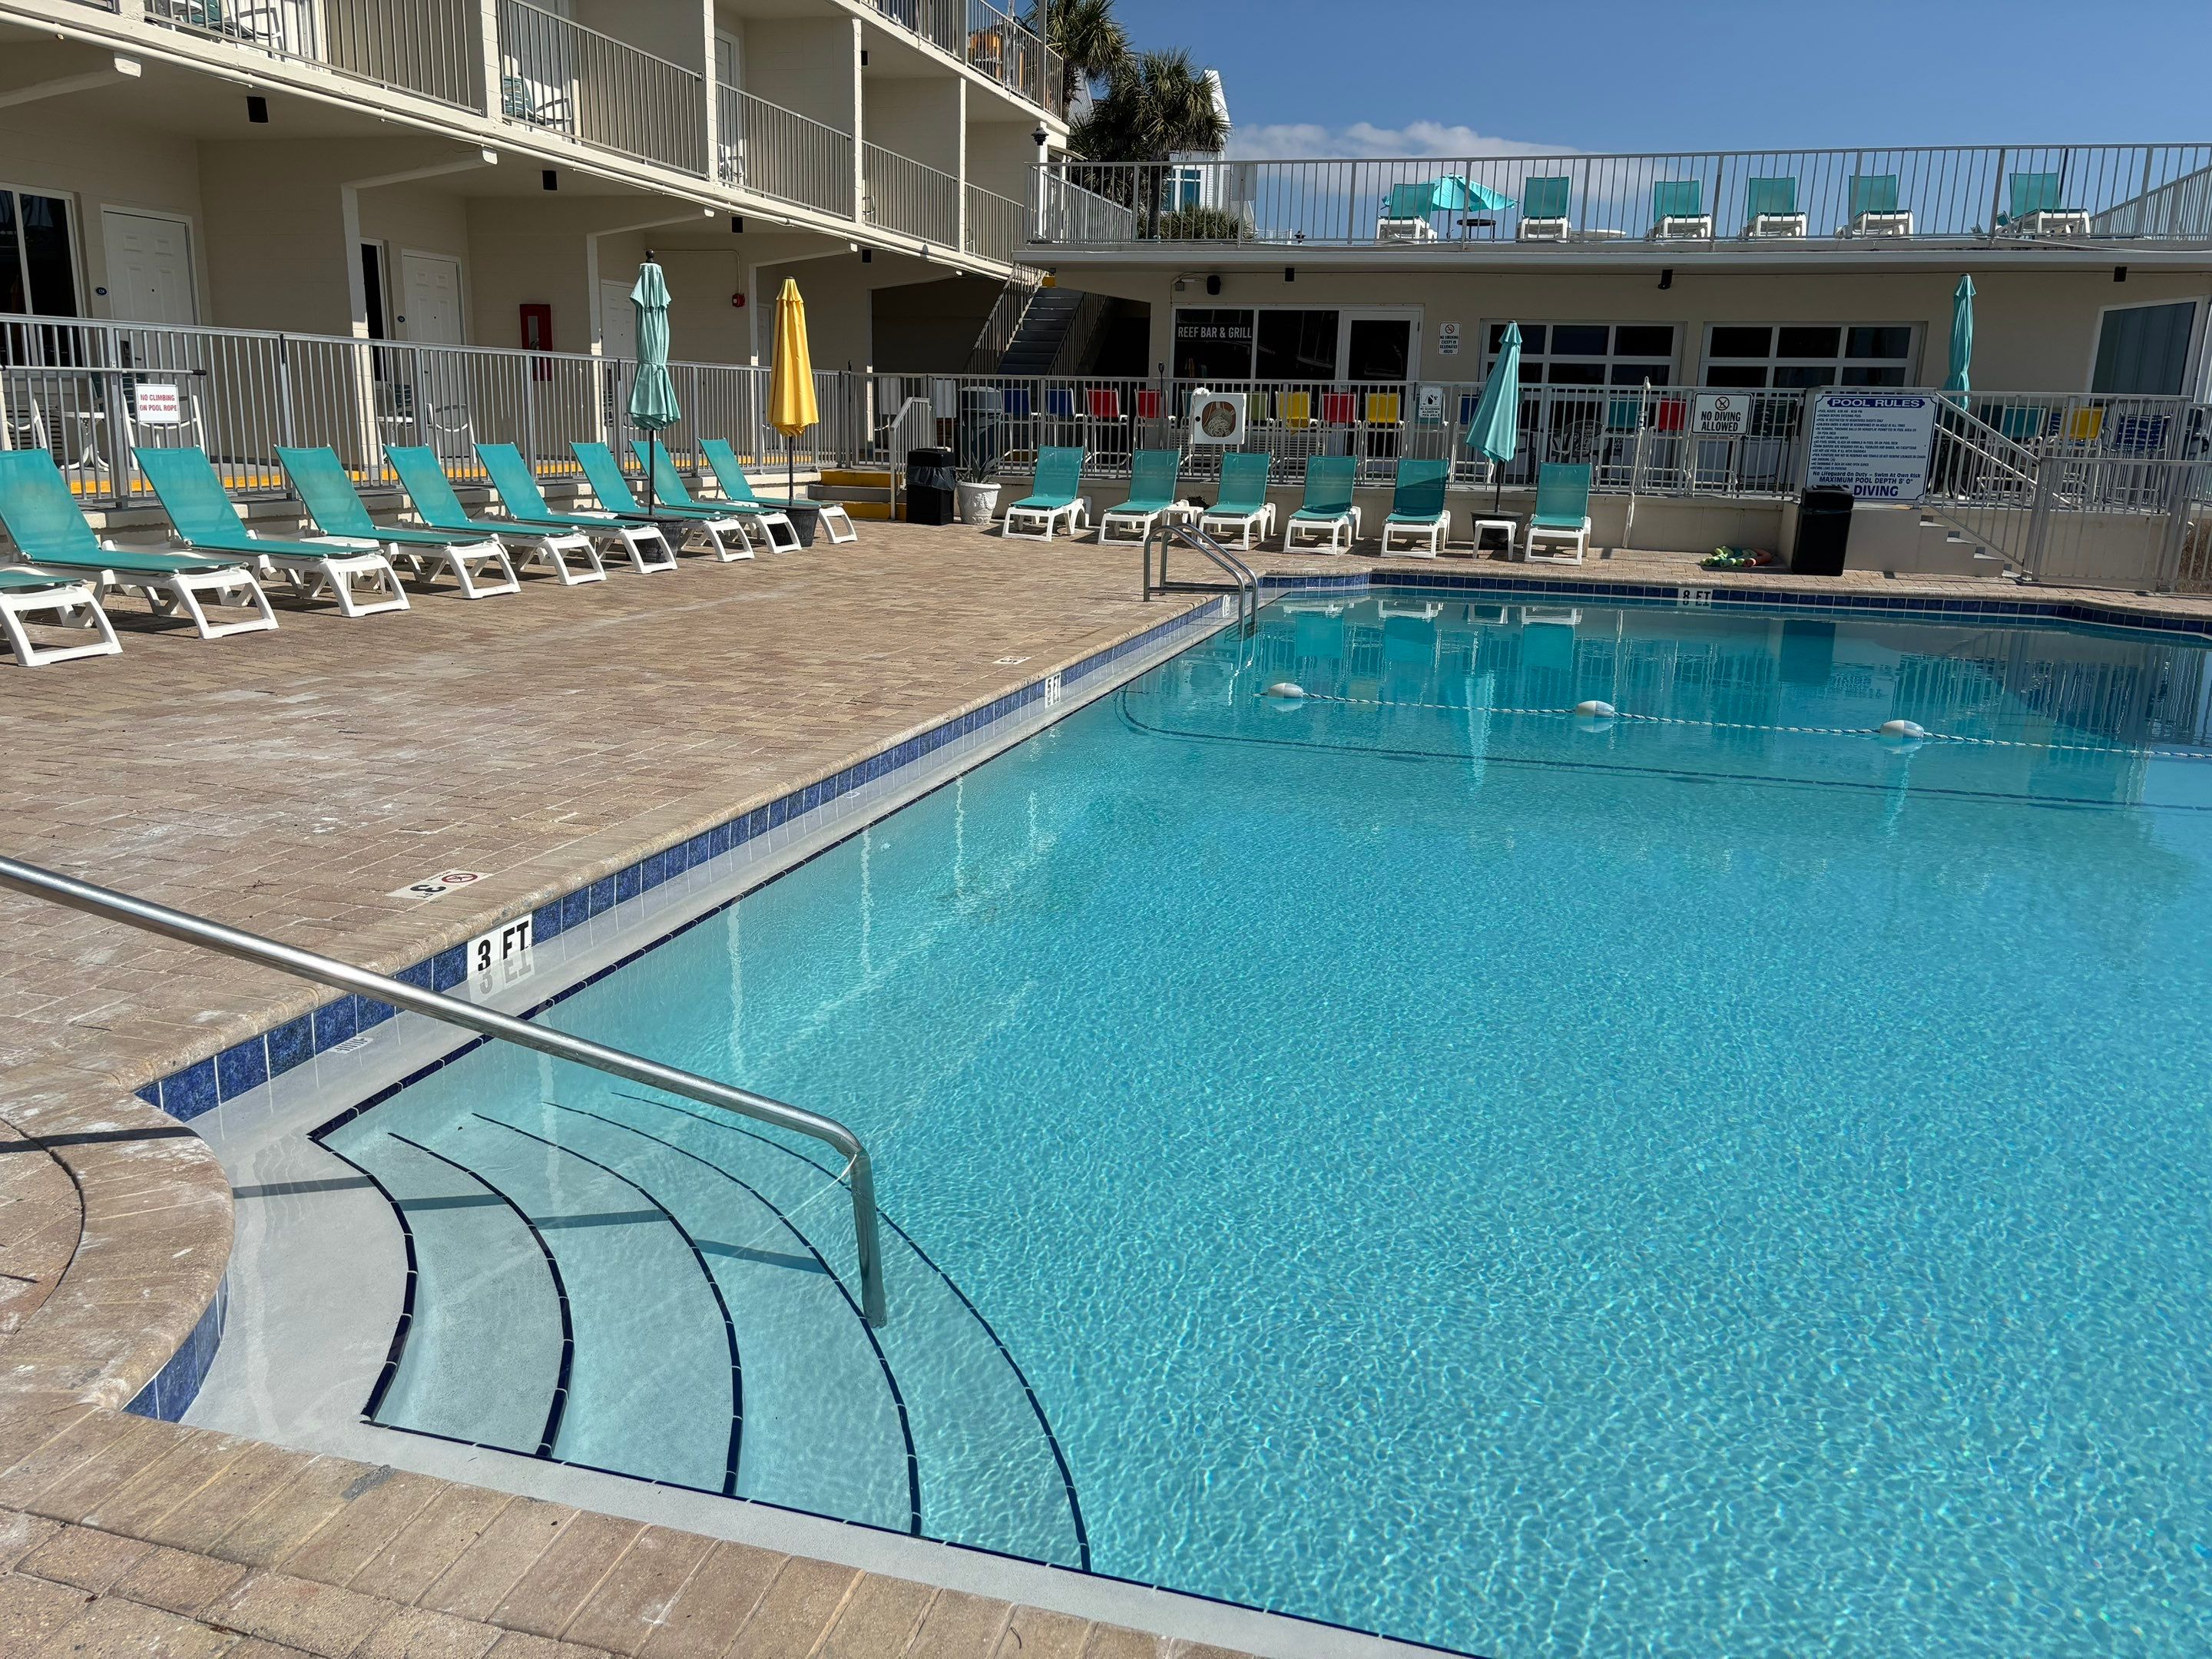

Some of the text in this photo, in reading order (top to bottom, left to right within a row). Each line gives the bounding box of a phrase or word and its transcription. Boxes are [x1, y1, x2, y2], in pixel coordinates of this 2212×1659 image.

[1177, 326, 1252, 338] REEF BAR & GRILL
[1832, 399, 1920, 408] POOL RULES
[1700, 411, 1741, 422] NO DIVING
[1701, 421, 1739, 432] ALLOWED
[1853, 485, 1899, 497] DIVING
[409, 884, 447, 892] 3
[478, 920, 529, 972] 3 FT
